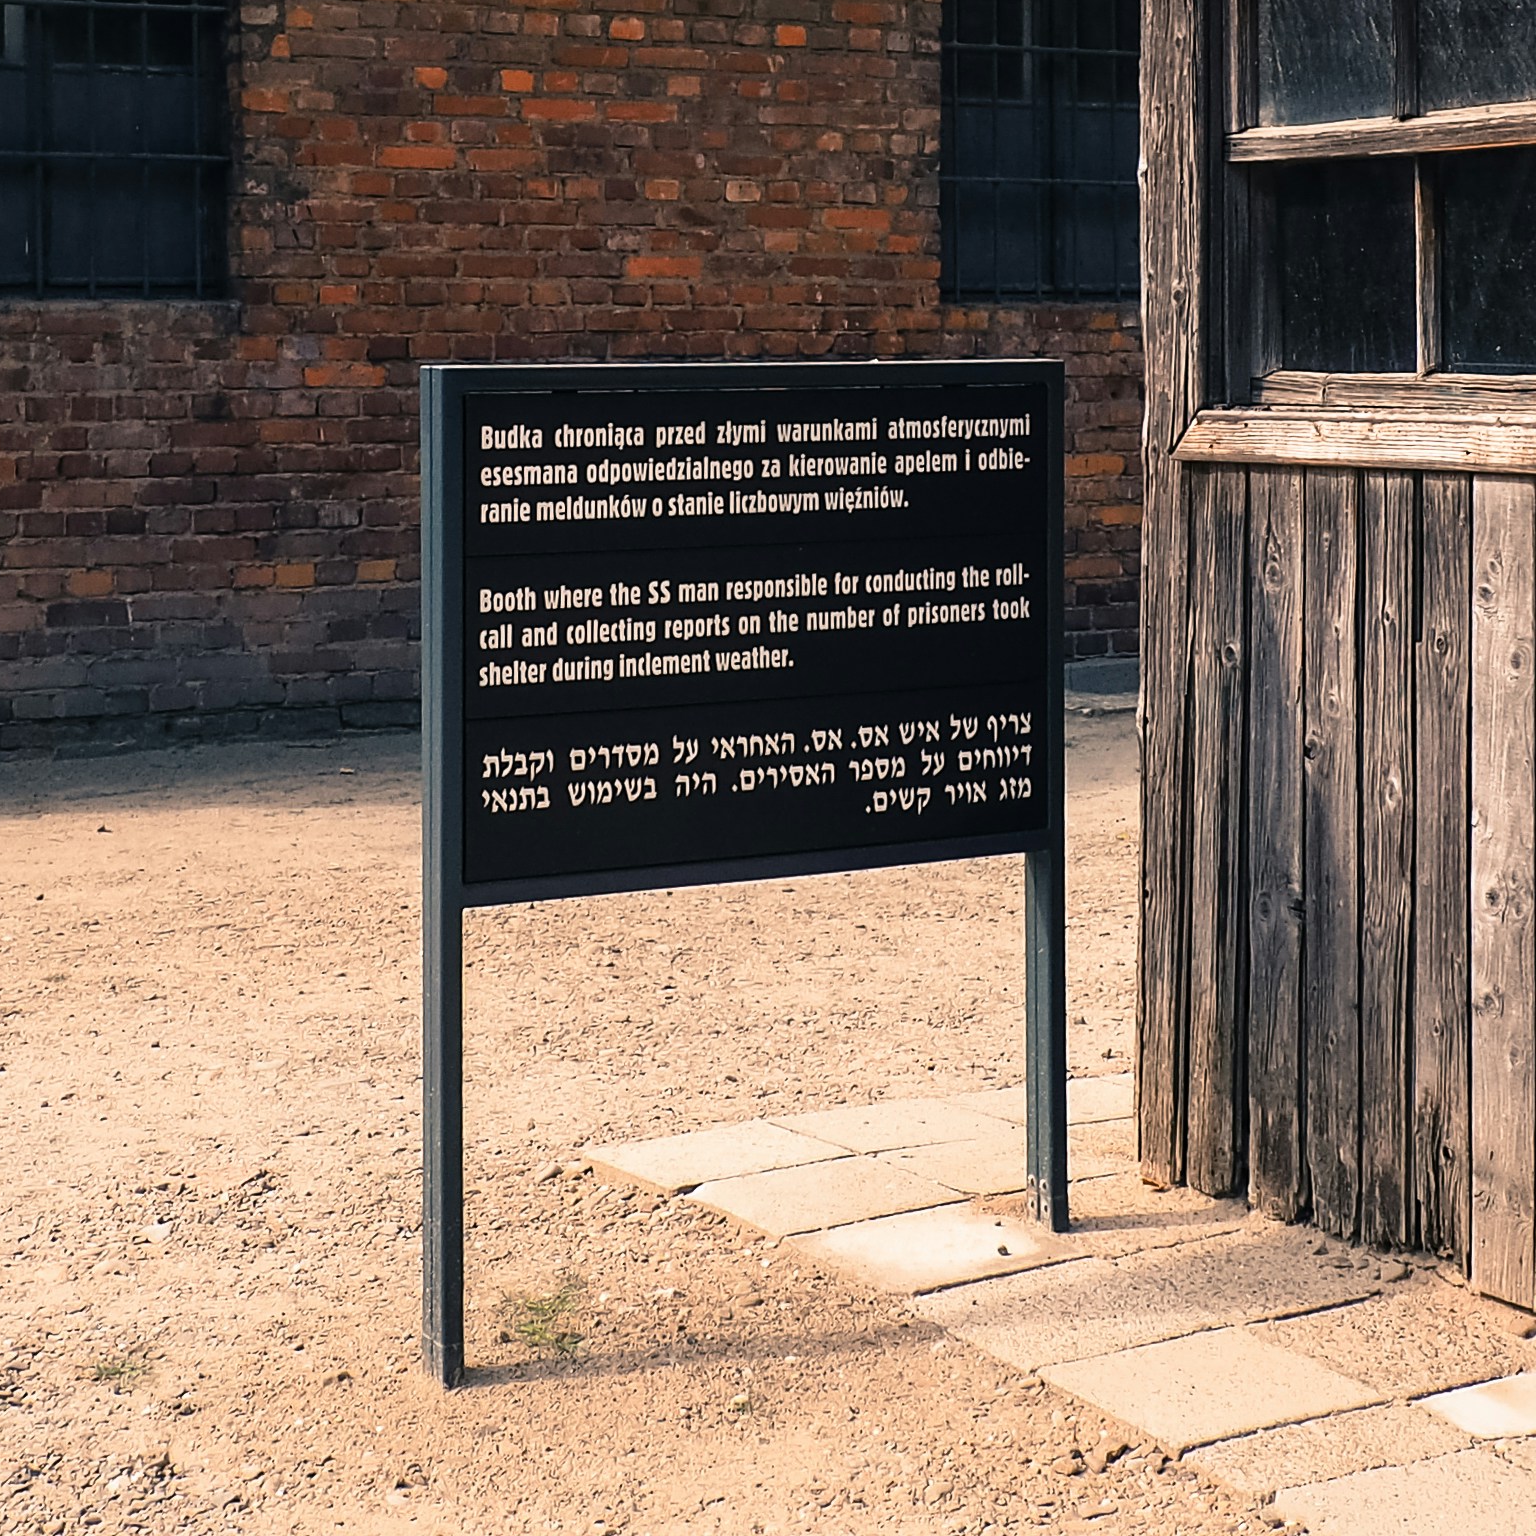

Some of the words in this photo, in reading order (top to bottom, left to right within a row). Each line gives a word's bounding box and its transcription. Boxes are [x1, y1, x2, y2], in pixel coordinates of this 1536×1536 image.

[481, 424, 543, 450] Budka
[554, 422, 645, 451] chroniąca
[655, 420, 706, 449] przed
[716, 419, 766, 447] złymi
[776, 417, 878, 443] warunkami
[887, 413, 1030, 440] atmosferycznymi
[480, 464, 578, 487] esesmana
[586, 455, 754, 486] odpowiedzialnego
[761, 458, 781, 478] za
[788, 451, 887, 477] kierowanie
[894, 449, 958, 476] apelem
[965, 448, 971, 471] i
[978, 447, 1031, 471] odbie-
[480, 497, 531, 524] ranie
[536, 494, 648, 522] meldunków
[651, 497, 663, 517] o
[667, 491, 725, 517] stanie
[729, 489, 820, 515] liczbowym
[824, 485, 909, 514] więźniów.
[479, 586, 537, 613] Booth
[543, 584, 603, 610] where
[609, 581, 641, 606] the
[648, 579, 671, 605] SS
[678, 582, 719, 603] man
[726, 572, 828, 602] responsible
[834, 571, 859, 595] for
[865, 567, 956, 594] conducting
[961, 565, 990, 588] the
[995, 562, 1030, 587] roll-
[479, 623, 513, 650] call
[521, 621, 558, 648] and
[566, 617, 656, 645] collecting
[664, 613, 731, 641] reports
[738, 615, 761, 635] on
[768, 609, 799, 633] the
[806, 605, 876, 632] number
[882, 603, 901, 627] of
[907, 601, 986, 628] prisoners
[992, 596, 1030, 620] took
[479, 659, 547, 687] shelter
[552, 655, 614, 682] during
[619, 649, 711, 678] inclement
[715, 645, 794, 672] weather.
[803, 728, 843, 753] אס.
[850, 724, 890, 749] אס.
[898, 720, 940, 745] איש
[949, 713, 979, 741] של
[986, 712, 1032, 743] צריף
[569, 742, 660, 771] מסדרים
[672, 734, 699, 765] על
[710, 731, 795, 760] האחראי
[957, 744, 1033, 772] דיווחים
[482, 747, 554, 782] וקבלת
[848, 756, 906, 782] מספר
[920, 748, 945, 776] על
[567, 776, 658, 807] בשימוש
[674, 771, 717, 797] היה
[731, 761, 835, 793] האסירים.
[999, 776, 1032, 801] מזג
[481, 785, 551, 813] בתנאי
[865, 786, 931, 815] קשים.
[944, 780, 987, 805] אויר
